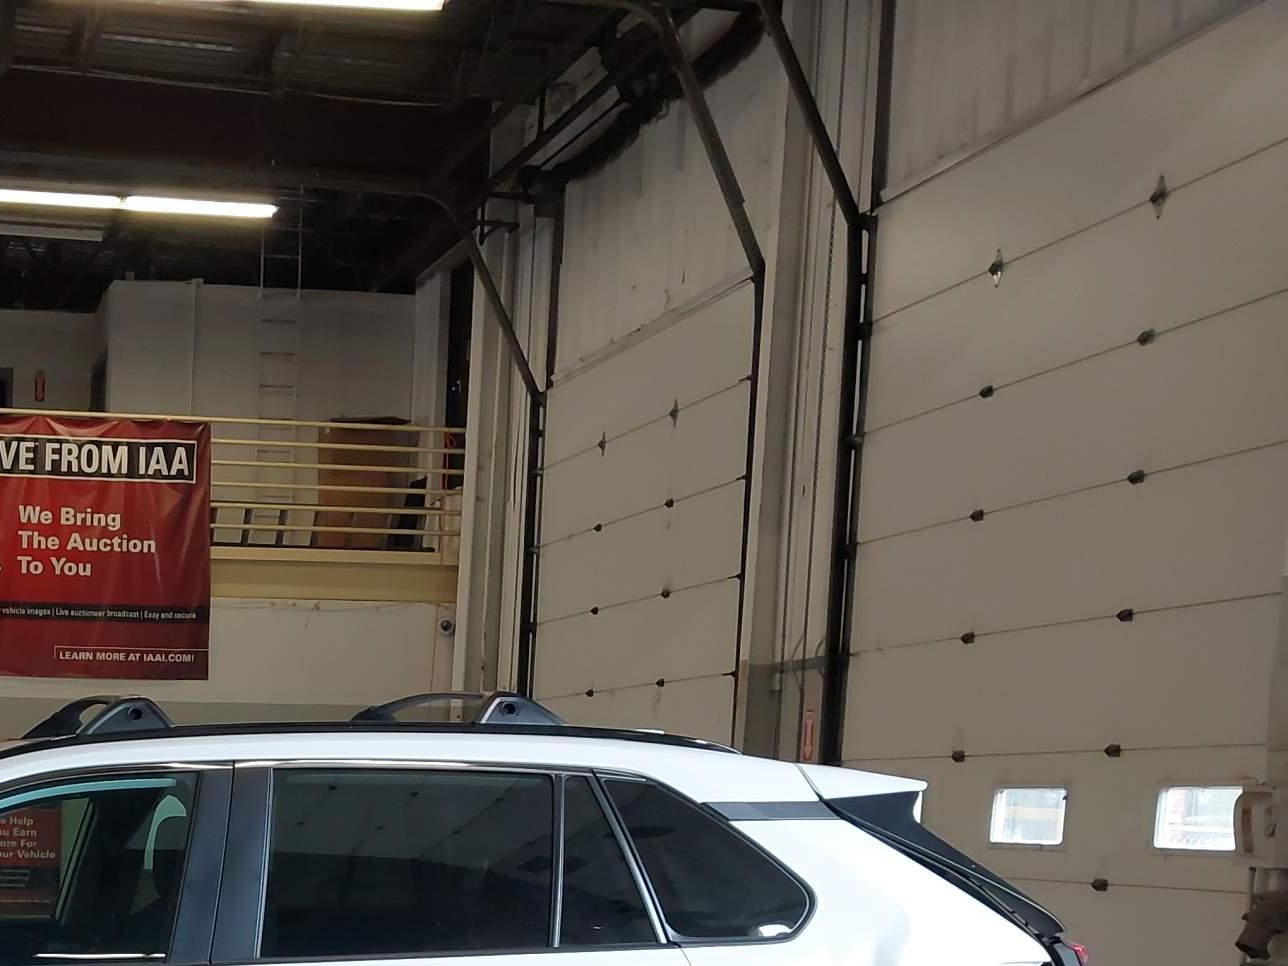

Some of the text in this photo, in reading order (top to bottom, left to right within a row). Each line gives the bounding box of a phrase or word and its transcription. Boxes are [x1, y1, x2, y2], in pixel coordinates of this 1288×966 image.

[45, 442, 129, 475] FROM
[138, 446, 190, 476] IAA
[19, 505, 121, 530] We Bring
[18, 531, 156, 553] The Auction
[17, 556, 92, 577] To You
[2, 606, 26, 615] vehicle
[27, 607, 51, 617] images
[55, 608, 70, 616] Live
[70, 609, 105, 618] auctioneer
[106, 610, 139, 619] broadcast
[144, 611, 160, 620] Easy
[174, 612, 197, 620] secure
[59, 651, 94, 661] LEARN
[96, 652, 126, 662] MORE
[127, 653, 141, 662] AT
[9, 816, 34, 827] Help
[13, 827, 37, 837] Earn
[20, 839, 38, 848] For
[17, 849, 56, 859] Vehicle
